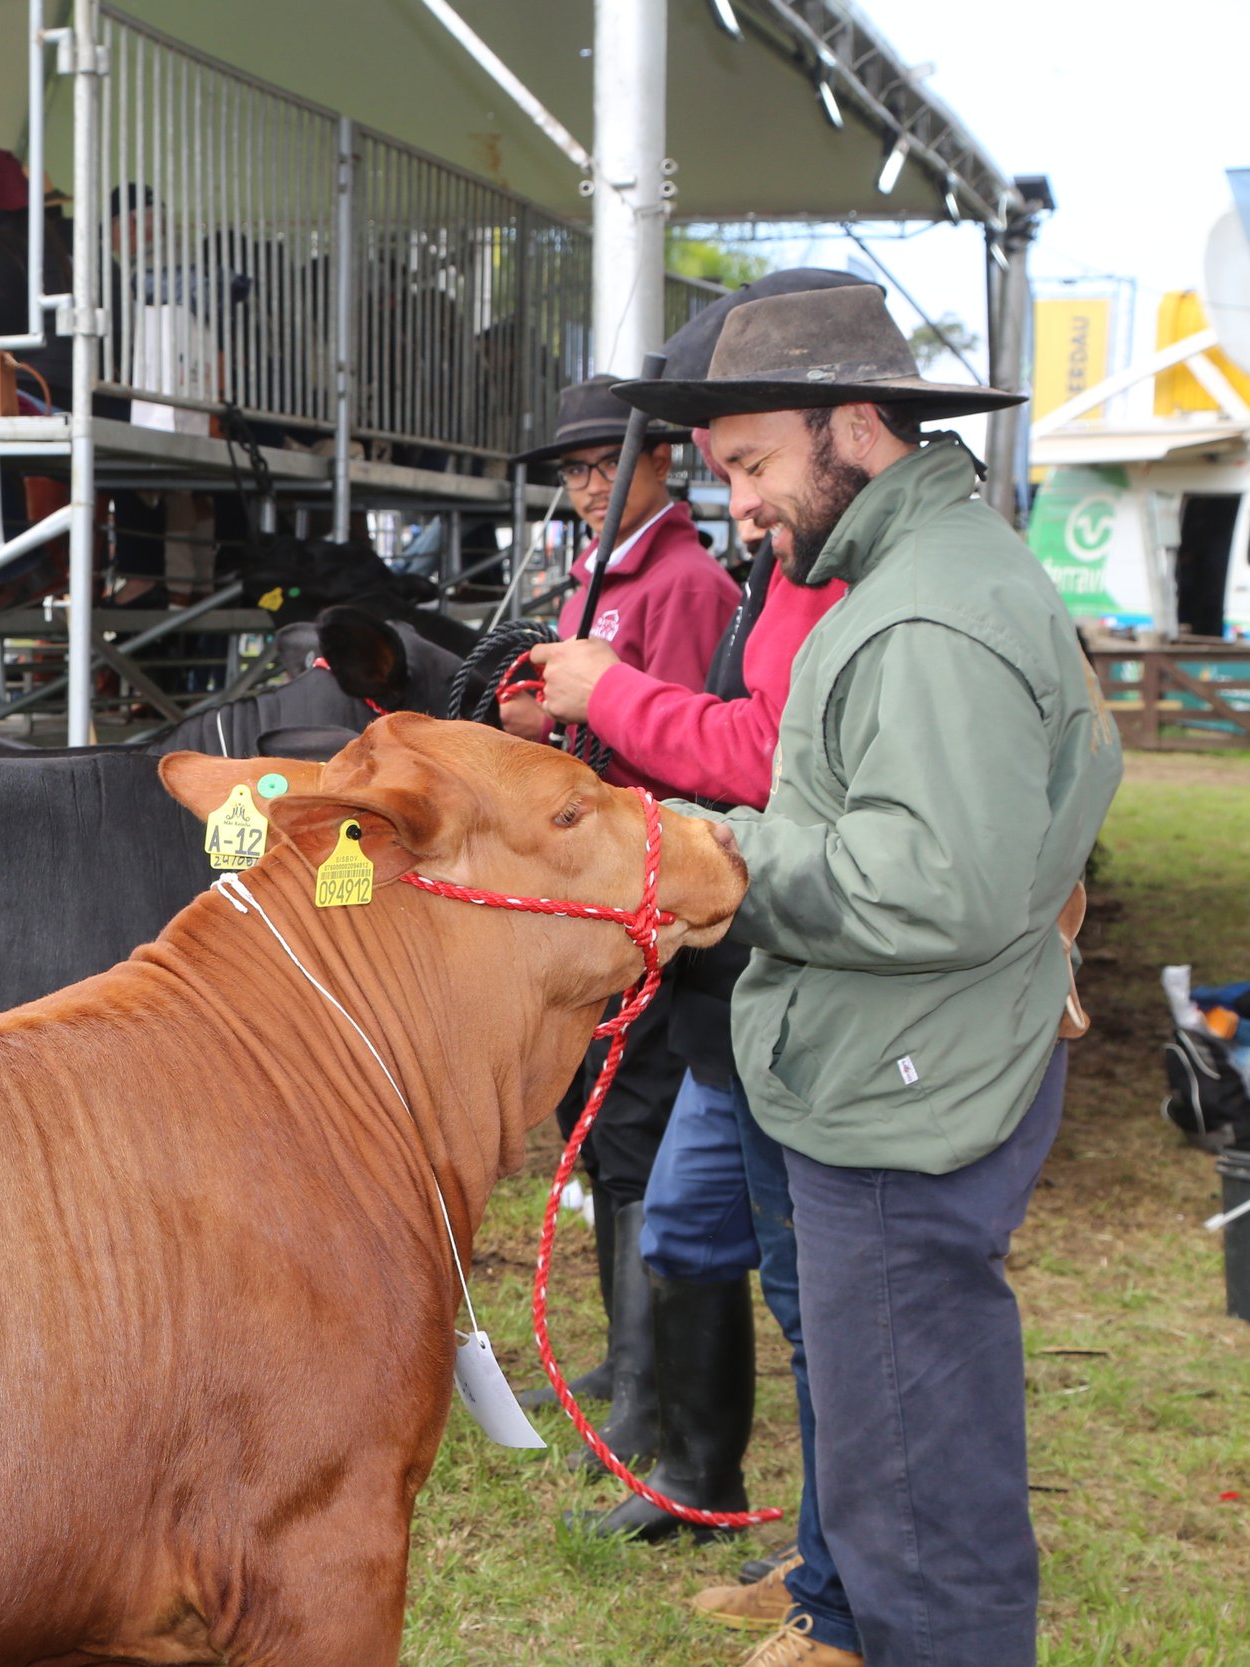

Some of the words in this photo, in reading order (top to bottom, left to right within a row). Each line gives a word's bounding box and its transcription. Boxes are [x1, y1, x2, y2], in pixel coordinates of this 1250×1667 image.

[1067, 315, 1090, 395] ERDAU
[208, 825, 262, 856] A-12
[319, 878, 370, 905] 094912
